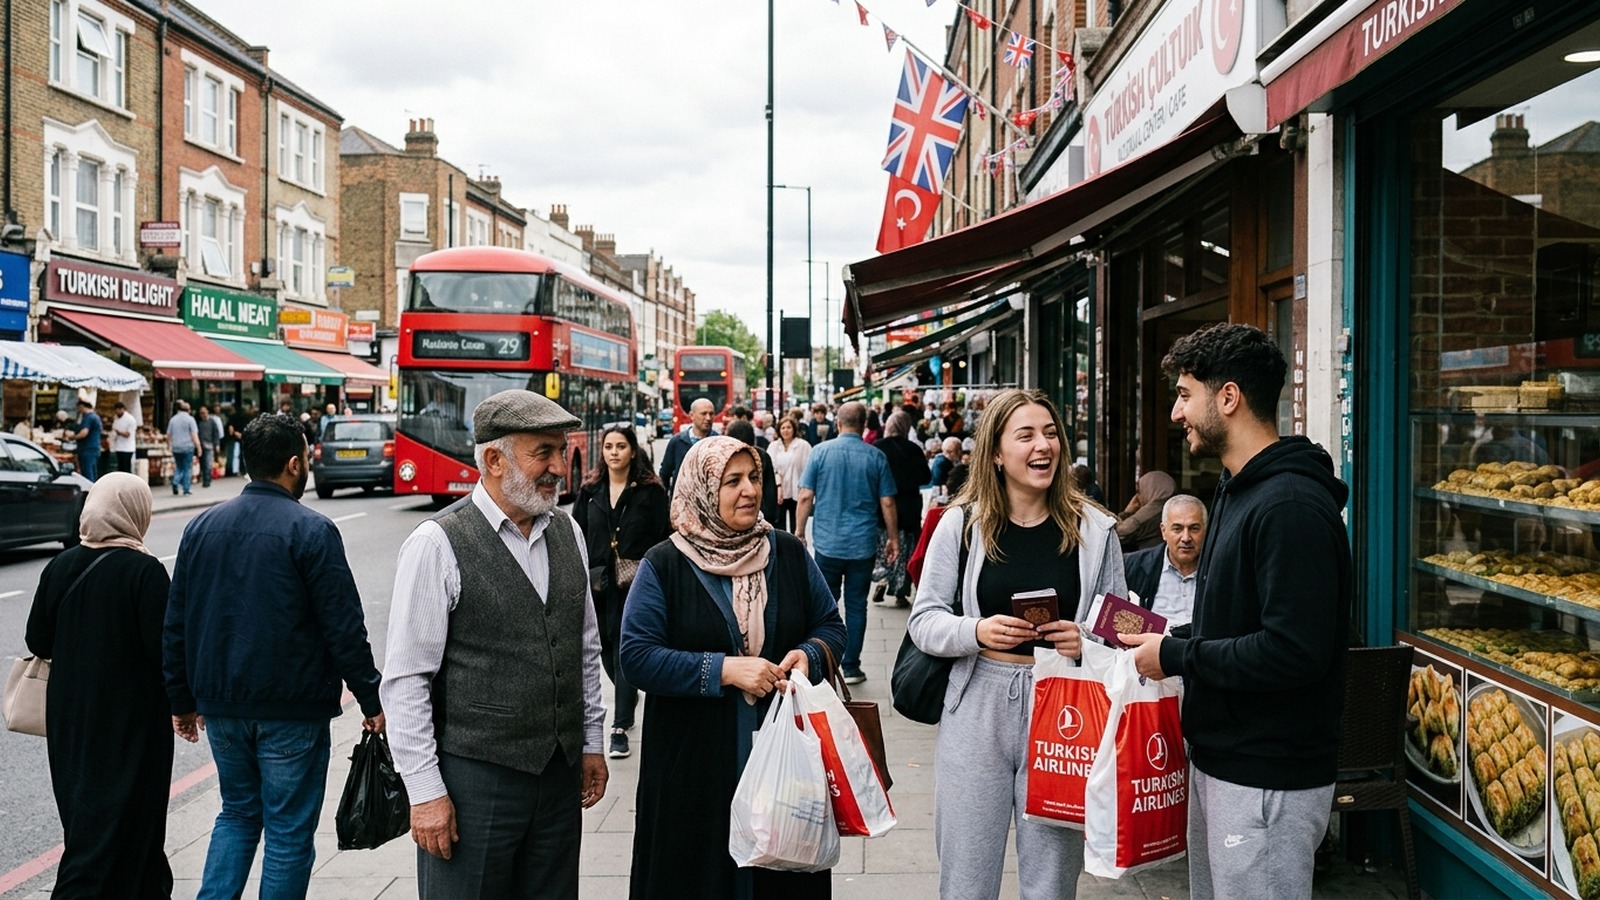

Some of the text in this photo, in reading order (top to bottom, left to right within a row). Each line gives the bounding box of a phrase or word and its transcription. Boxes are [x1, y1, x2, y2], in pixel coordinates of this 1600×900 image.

[1362, 0, 1445, 57] TURKI
[57, 267, 174, 308] TURKISH DELIGHT
[191, 294, 236, 322] HALAL
[498, 338, 520, 354] 29
[1033, 757, 1092, 778] AIRLINE
[1131, 787, 1185, 814] AIRLINES
